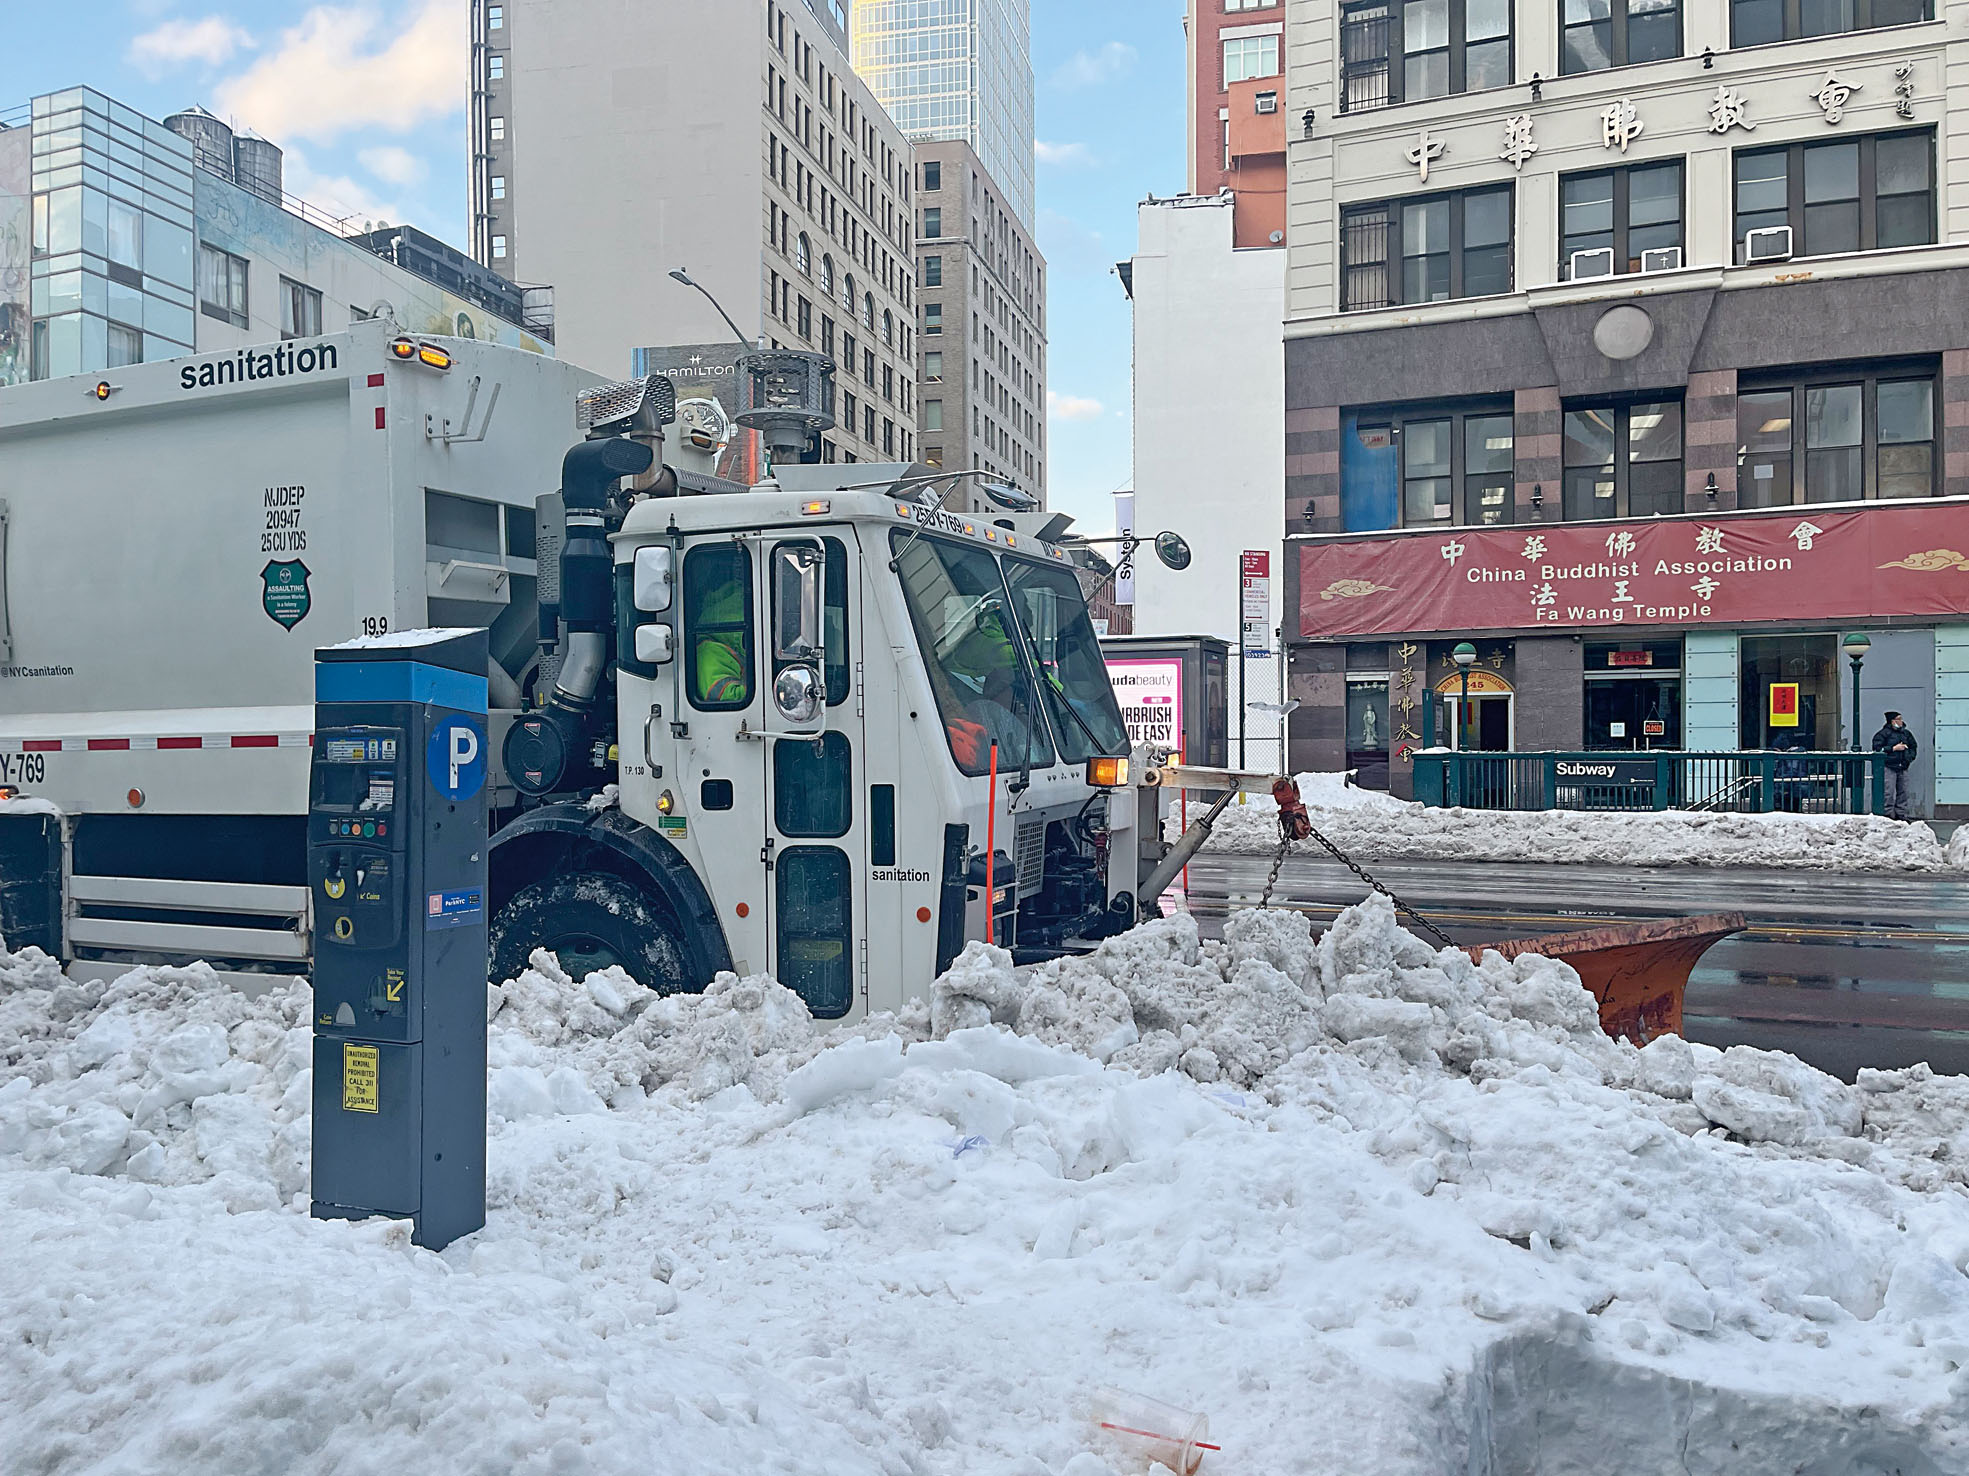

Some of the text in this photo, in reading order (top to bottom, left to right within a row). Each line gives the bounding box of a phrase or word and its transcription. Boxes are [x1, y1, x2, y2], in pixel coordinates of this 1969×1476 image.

[1403, 69, 1864, 184] 中華佛教會
[180, 342, 338, 390] sanitation
[656, 364, 735, 377] HAMILTON
[264, 485, 305, 508] NJDEP
[266, 509, 301, 530] 20947
[261, 530, 307, 552] 25 CU YDS
[1440, 520, 1824, 568] 中華佛教會
[1466, 556, 1793, 584] China Buddhist Association
[267, 584, 305, 592] ASSAULTING
[1245, 579, 1250, 587] 3
[1529, 576, 1721, 607] 法王寺
[1535, 602, 1712, 622] Fa Wang Temple
[361, 616, 388, 636] 19.9
[1245, 623, 1250, 631] 5
[1, 664, 74, 678] @NYCsanitation
[1112, 674, 1173, 687] udabeauty
[1121, 706, 1172, 723] IRBRUSH
[1128, 724, 1172, 741] DE EASY
[1645, 724, 1662, 733] CLOSED
[449, 727, 478, 789] P
[624, 766, 645, 775] T.P. 130
[1556, 762, 1616, 778] Subway
[872, 868, 930, 882] sanitation
[366, 892, 381, 900] Coins
[347, 1051, 376, 1059] UNAUTHORIZED
[352, 1060, 370, 1068] REMOVAL
[347, 1068, 375, 1078] PROHIBITED
[349, 1078, 363, 1086] CALL
[347, 1096, 375, 1106] ASSISTANCE
